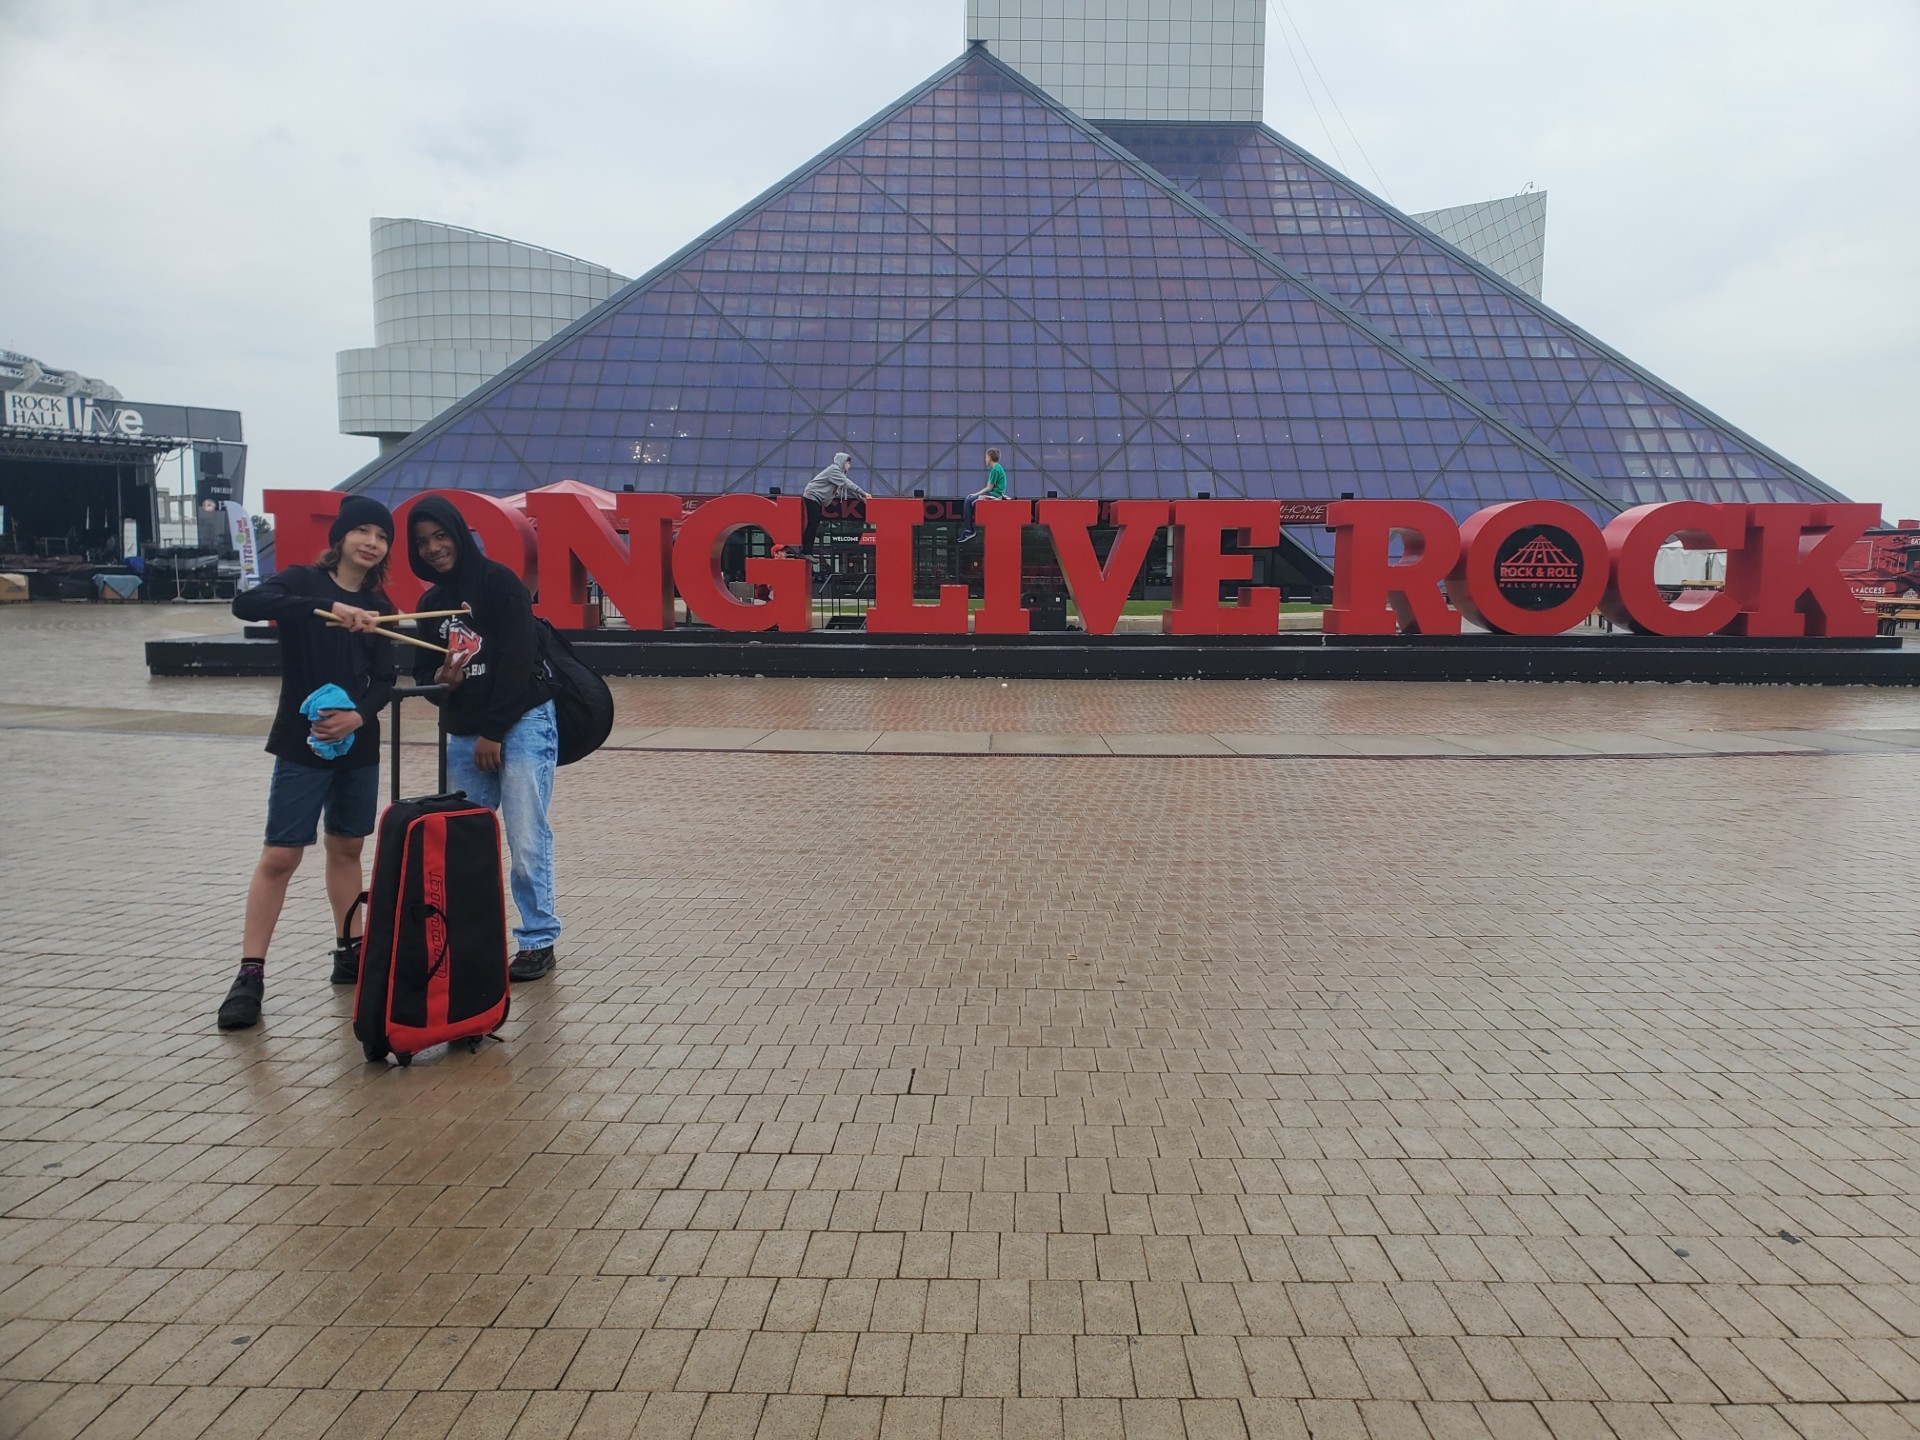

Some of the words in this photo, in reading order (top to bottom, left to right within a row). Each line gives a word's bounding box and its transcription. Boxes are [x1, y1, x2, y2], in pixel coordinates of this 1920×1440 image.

[11, 394, 62, 412] ROCK
[13, 410, 64, 426] HALL
[73, 396, 144, 434] live
[867, 498, 1280, 634] LIVE
[1325, 500, 1882, 638] ROCK
[1500, 566, 1533, 577] ROCK
[1536, 567, 1545, 577] &
[1547, 567, 1578, 577] ROLL
